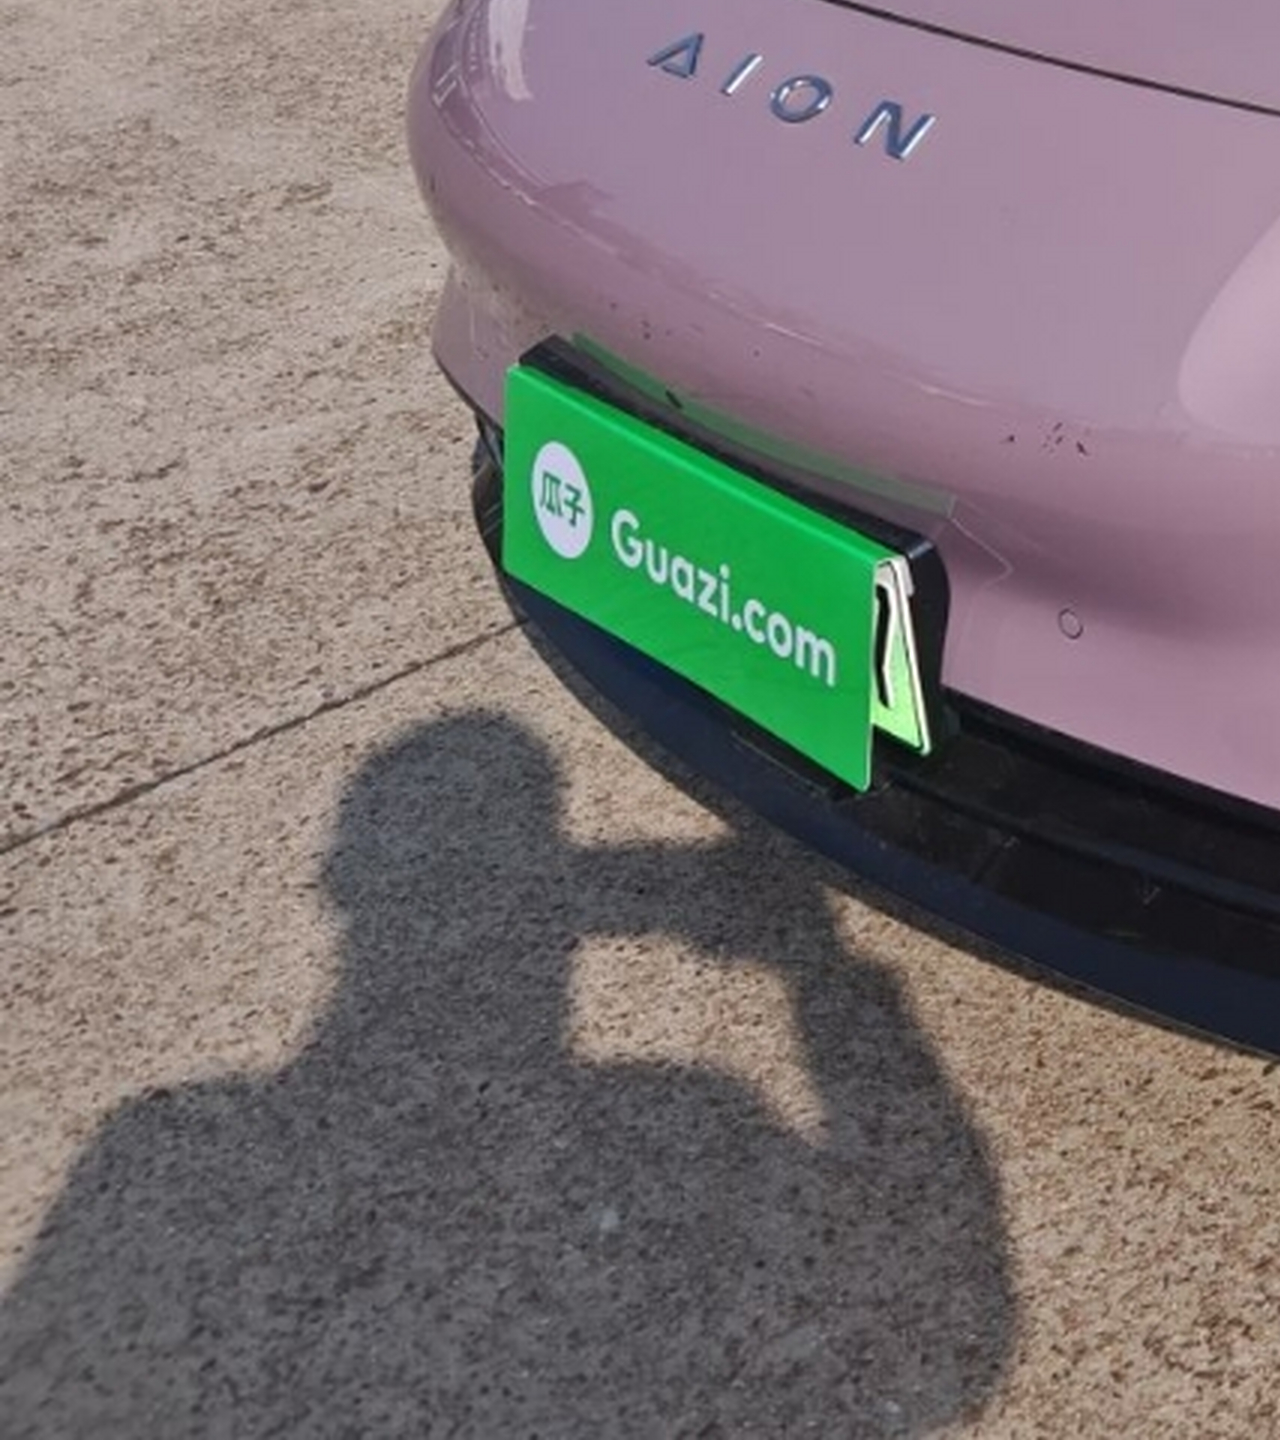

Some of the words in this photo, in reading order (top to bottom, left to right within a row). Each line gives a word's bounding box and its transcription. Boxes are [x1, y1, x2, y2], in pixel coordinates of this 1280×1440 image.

[646, 33, 937, 160] AION
[539, 470, 586, 528] 瓜子
[610, 508, 837, 688] Guazi.com
